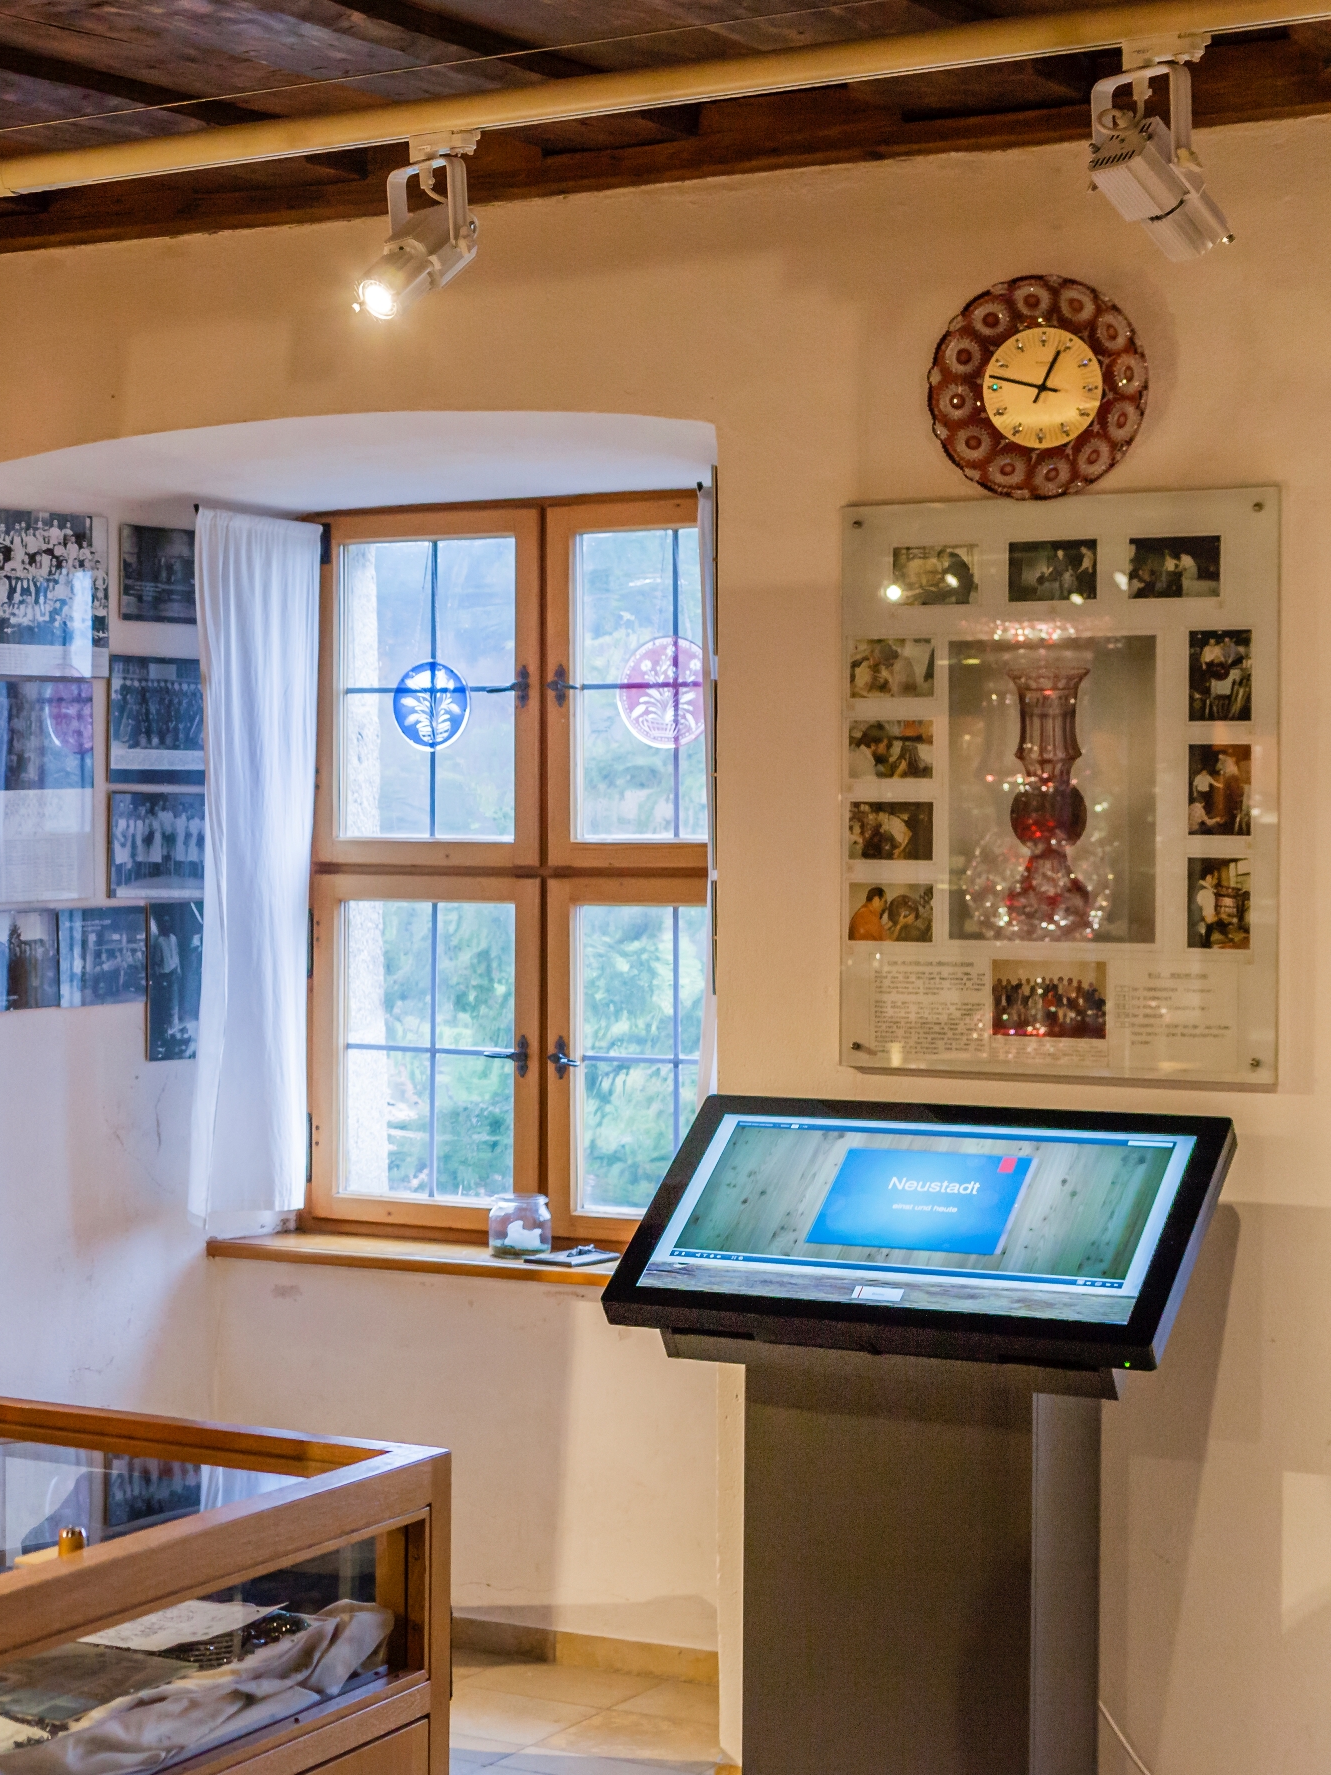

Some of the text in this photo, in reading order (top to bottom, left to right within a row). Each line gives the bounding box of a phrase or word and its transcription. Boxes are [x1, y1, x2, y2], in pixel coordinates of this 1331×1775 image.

[887, 1176, 981, 1195] Neustadt
[891, 1202, 958, 1213] einst und heute
